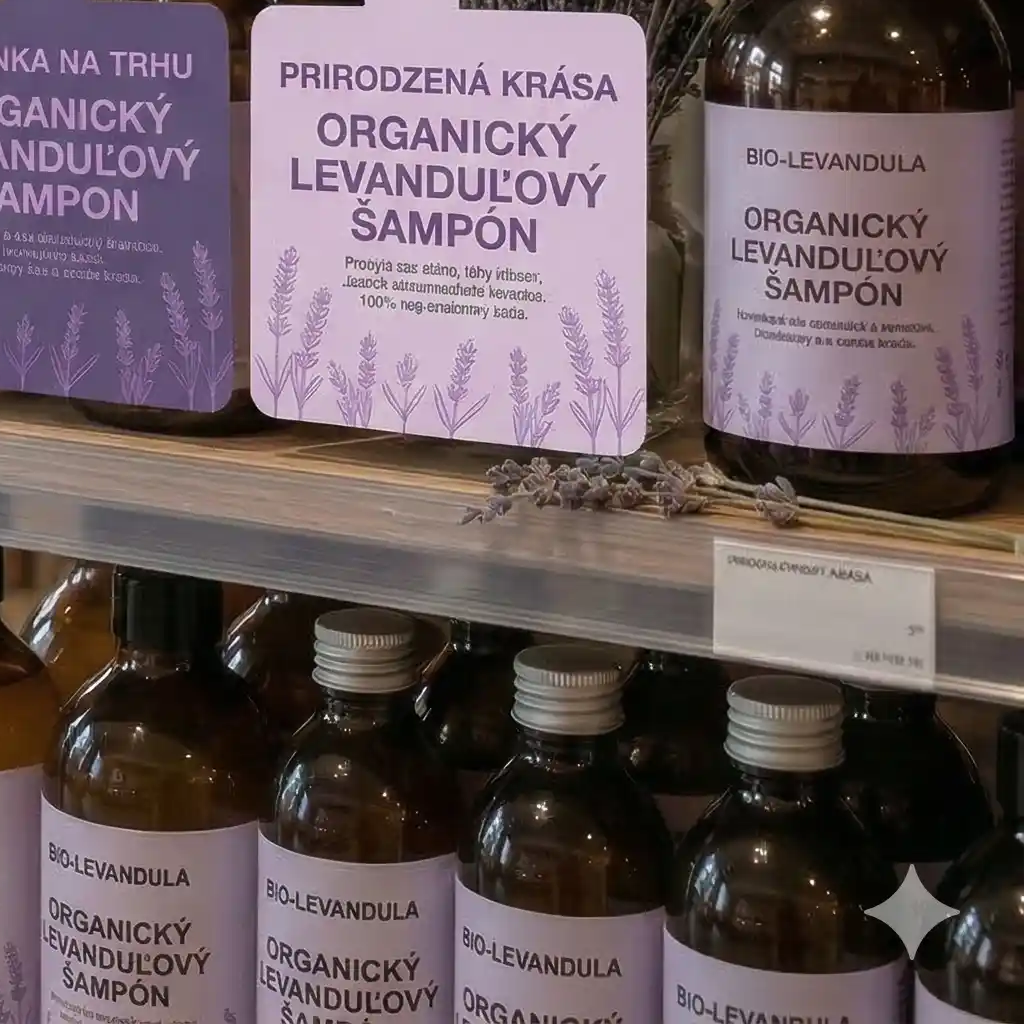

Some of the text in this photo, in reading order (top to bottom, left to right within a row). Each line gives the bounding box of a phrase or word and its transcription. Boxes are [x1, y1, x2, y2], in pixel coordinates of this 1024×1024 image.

[59, 49, 102, 76] NA
[109, 51, 193, 79] TRHU
[279, 61, 619, 102] PRIRODZENÁ KRÁSA
[316, 112, 577, 159] ORGANICKÝ
[745, 147, 927, 173] BIO-LEVANDULA
[290, 157, 607, 209] LEVANDUĽOVÝ
[350, 198, 538, 253] ŠAMPÓN
[743, 206, 929, 240] ORGANICKÝ
[731, 237, 949, 273] LEVANDUĽOVÝ
[360, 295, 397, 309] 100%
[764, 268, 903, 307] ŠAMPÓN
[47, 841, 191, 888] BIO-LEVANDULA
[47, 896, 192, 946] ORGANICKÝ
[265, 877, 420, 922] BIO-LEVANDULA
[265, 935, 421, 983] ORGANICKÝ
[461, 925, 623, 979] BIO-LEVANDULA
[61, 960, 170, 1008] ŠAMPÓN
[259, 959, 439, 1015] LEVANDUĽOVÝ
[462, 986, 624, 1024] ORGAN
[676, 984, 851, 1024] BIO-LEVAN
